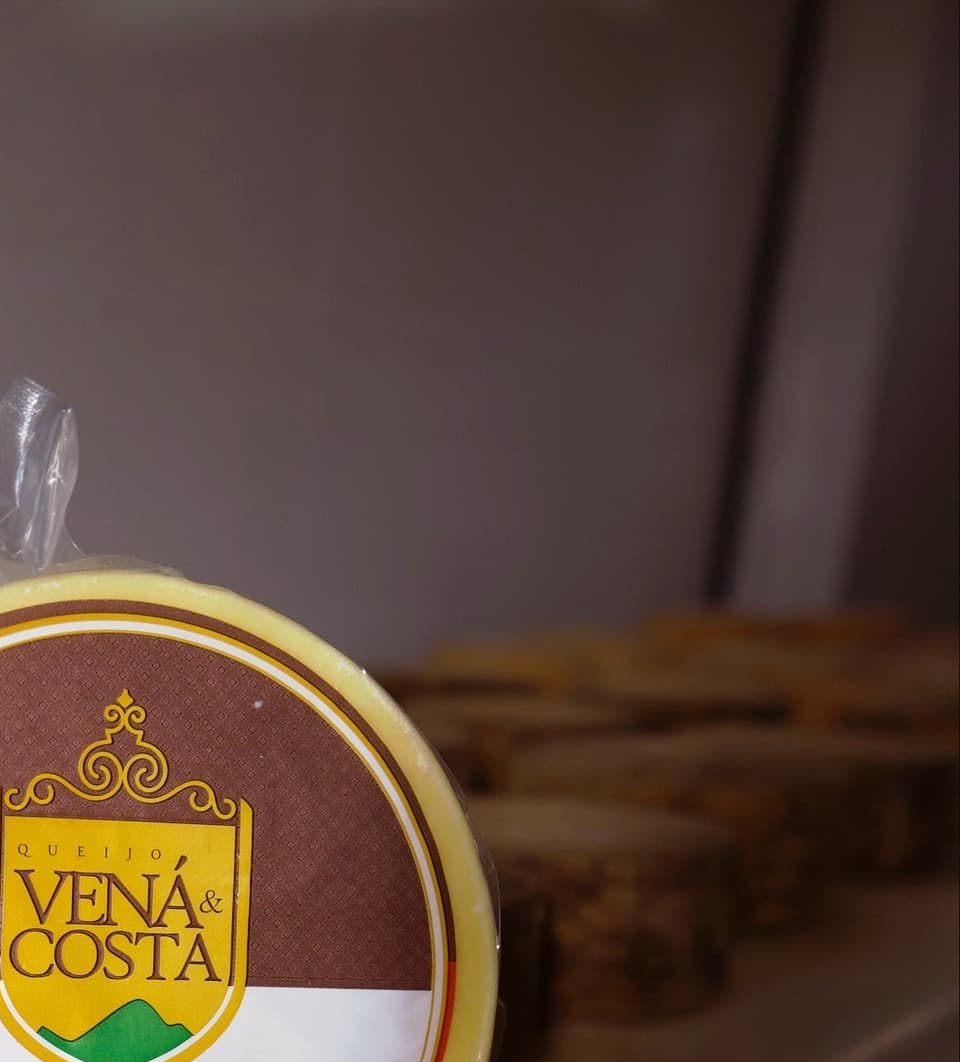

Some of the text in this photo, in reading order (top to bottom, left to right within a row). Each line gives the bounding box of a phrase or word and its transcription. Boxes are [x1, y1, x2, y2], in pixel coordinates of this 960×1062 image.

[18, 843, 162, 861] QUEIJO
[14, 855, 223, 929] VENÁ &
[9, 927, 222, 982] COSTA
